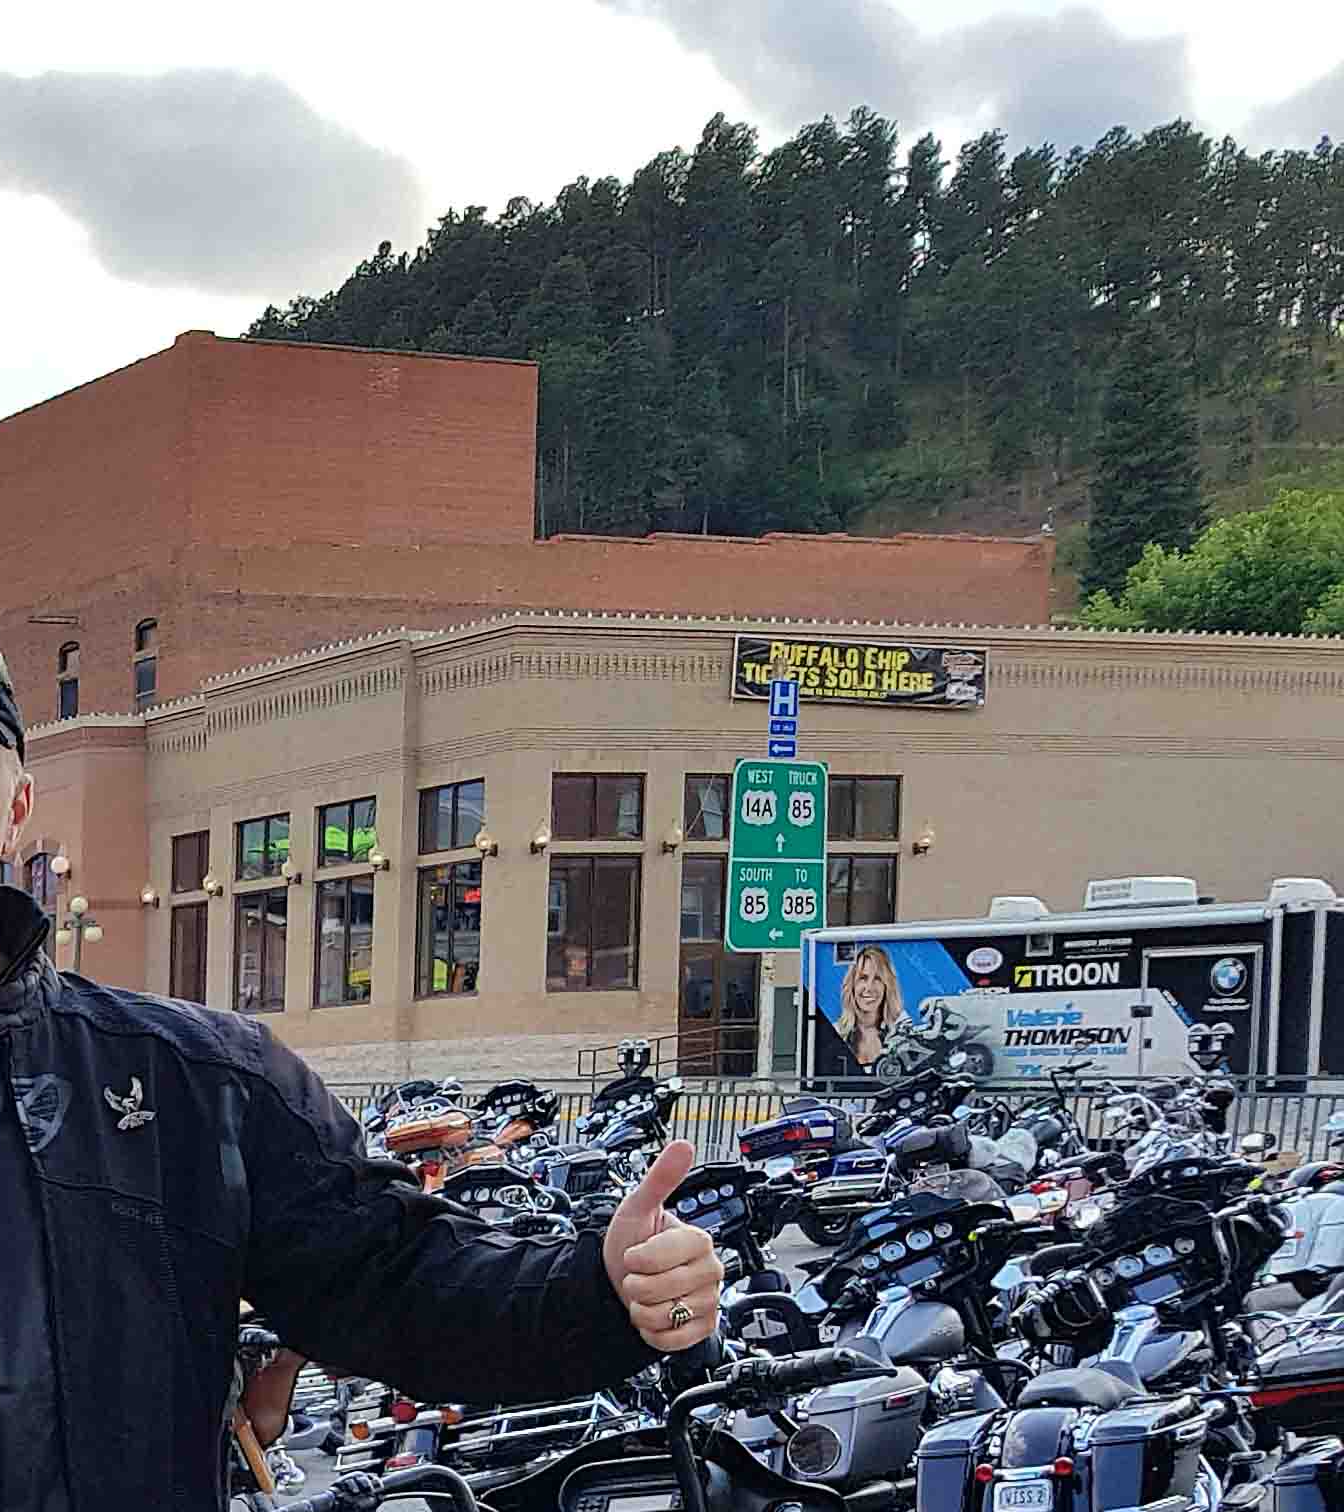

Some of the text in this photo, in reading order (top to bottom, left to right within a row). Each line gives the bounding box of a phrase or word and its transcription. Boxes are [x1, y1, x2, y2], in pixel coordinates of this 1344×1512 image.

[770, 642, 910, 671] BUFFALO CHIP
[743, 662, 820, 688] TICETS
[825, 667, 878, 690] SOLD
[883, 671, 935, 693] HERE
[773, 683, 795, 716] H
[748, 771, 818, 785] WEST TRUCK
[745, 798, 812, 819] 14A 85
[739, 868, 808, 882] SOUTH TO
[744, 896, 815, 915] 85 385
[1033, 961, 1120, 986] TROON
[1007, 1000, 1083, 1026] Valerie
[1004, 1026, 1132, 1047] THOMPSON
